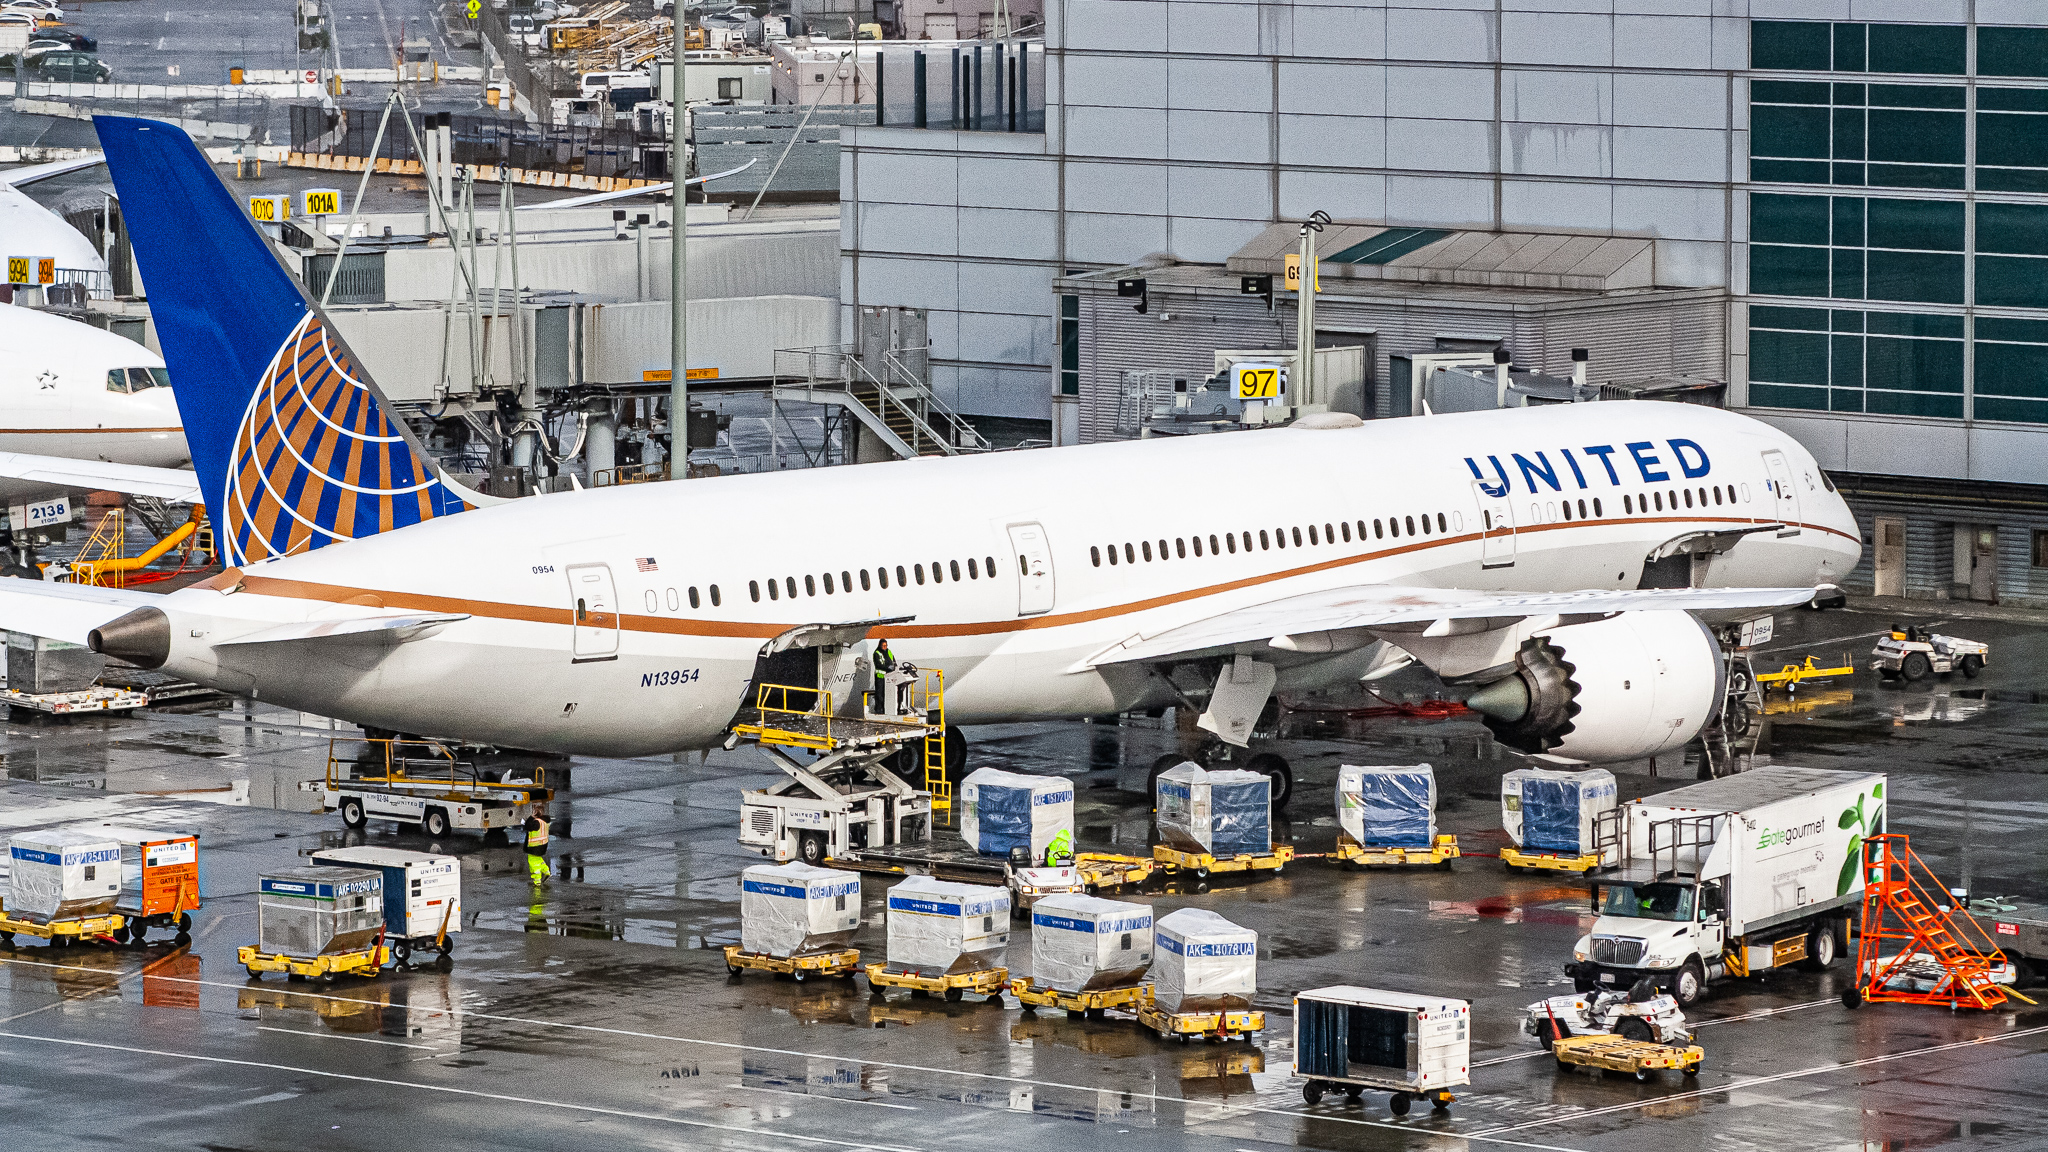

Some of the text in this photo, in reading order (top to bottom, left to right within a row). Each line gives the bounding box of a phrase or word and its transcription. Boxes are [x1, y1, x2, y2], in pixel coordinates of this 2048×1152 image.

[252, 200, 274, 220] 101C
[308, 194, 334, 213] 101A
[10, 260, 28, 282] 99A
[39, 261, 54, 282] 99A
[1242, 371, 1275, 397] 97
[1464, 439, 1711, 498] UNITED
[31, 504, 65, 519] 2138
[532, 565, 555, 574] 0954
[1754, 625, 1771, 636] 0954
[641, 668, 700, 688] N13954
[84, 850, 106, 863] 12541
[108, 849, 119, 861] UA
[160, 877, 175, 885] GATE
[811, 886, 825, 900] AKE
[850, 881, 859, 894] UA
[1052, 918, 1069, 926] UNITED
[1188, 943, 1253, 957] AKE 14078 UA
[1430, 1012, 1452, 1021] UNITED
